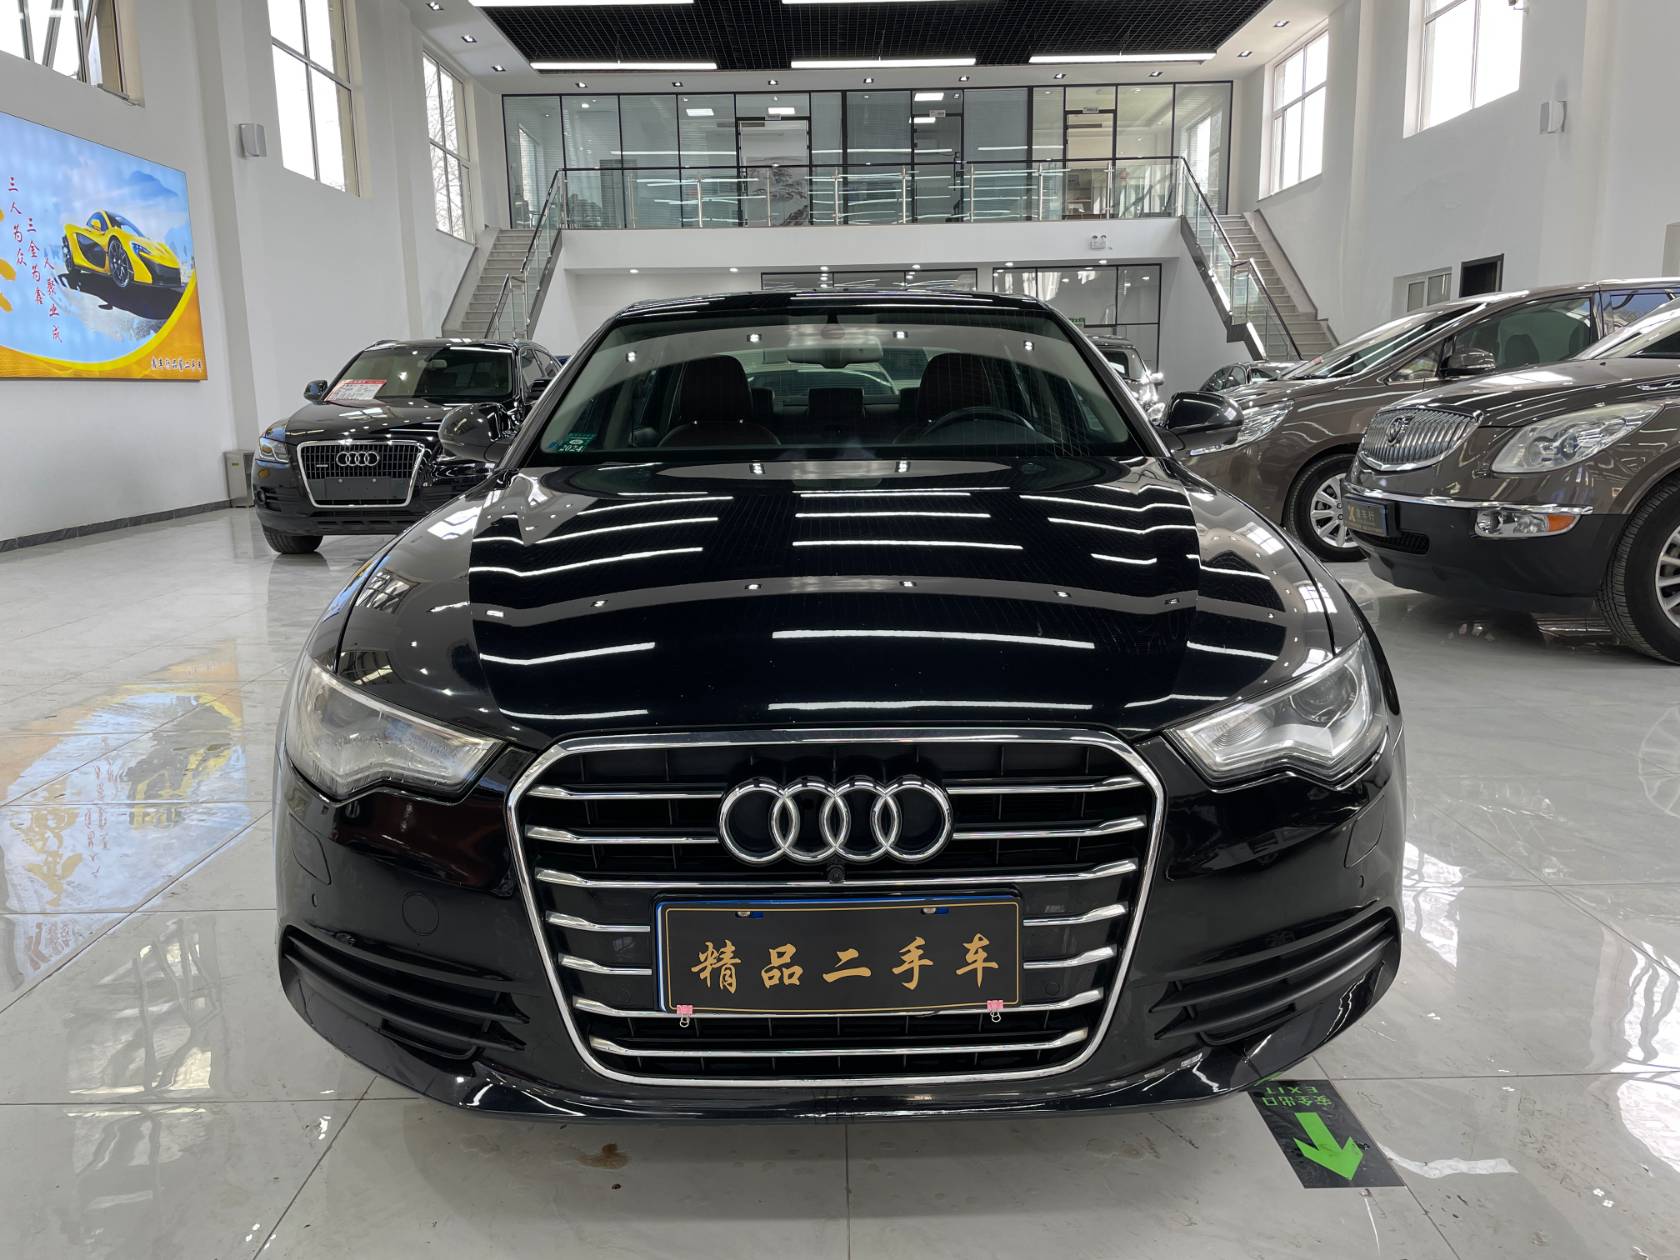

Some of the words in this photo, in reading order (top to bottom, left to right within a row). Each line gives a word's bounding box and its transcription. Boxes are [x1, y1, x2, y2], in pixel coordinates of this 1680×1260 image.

[691, 933, 998, 994] 精品二手车
[1266, 1086, 1318, 1094] EXIT
[1262, 1095, 1332, 1107] 安全出口
